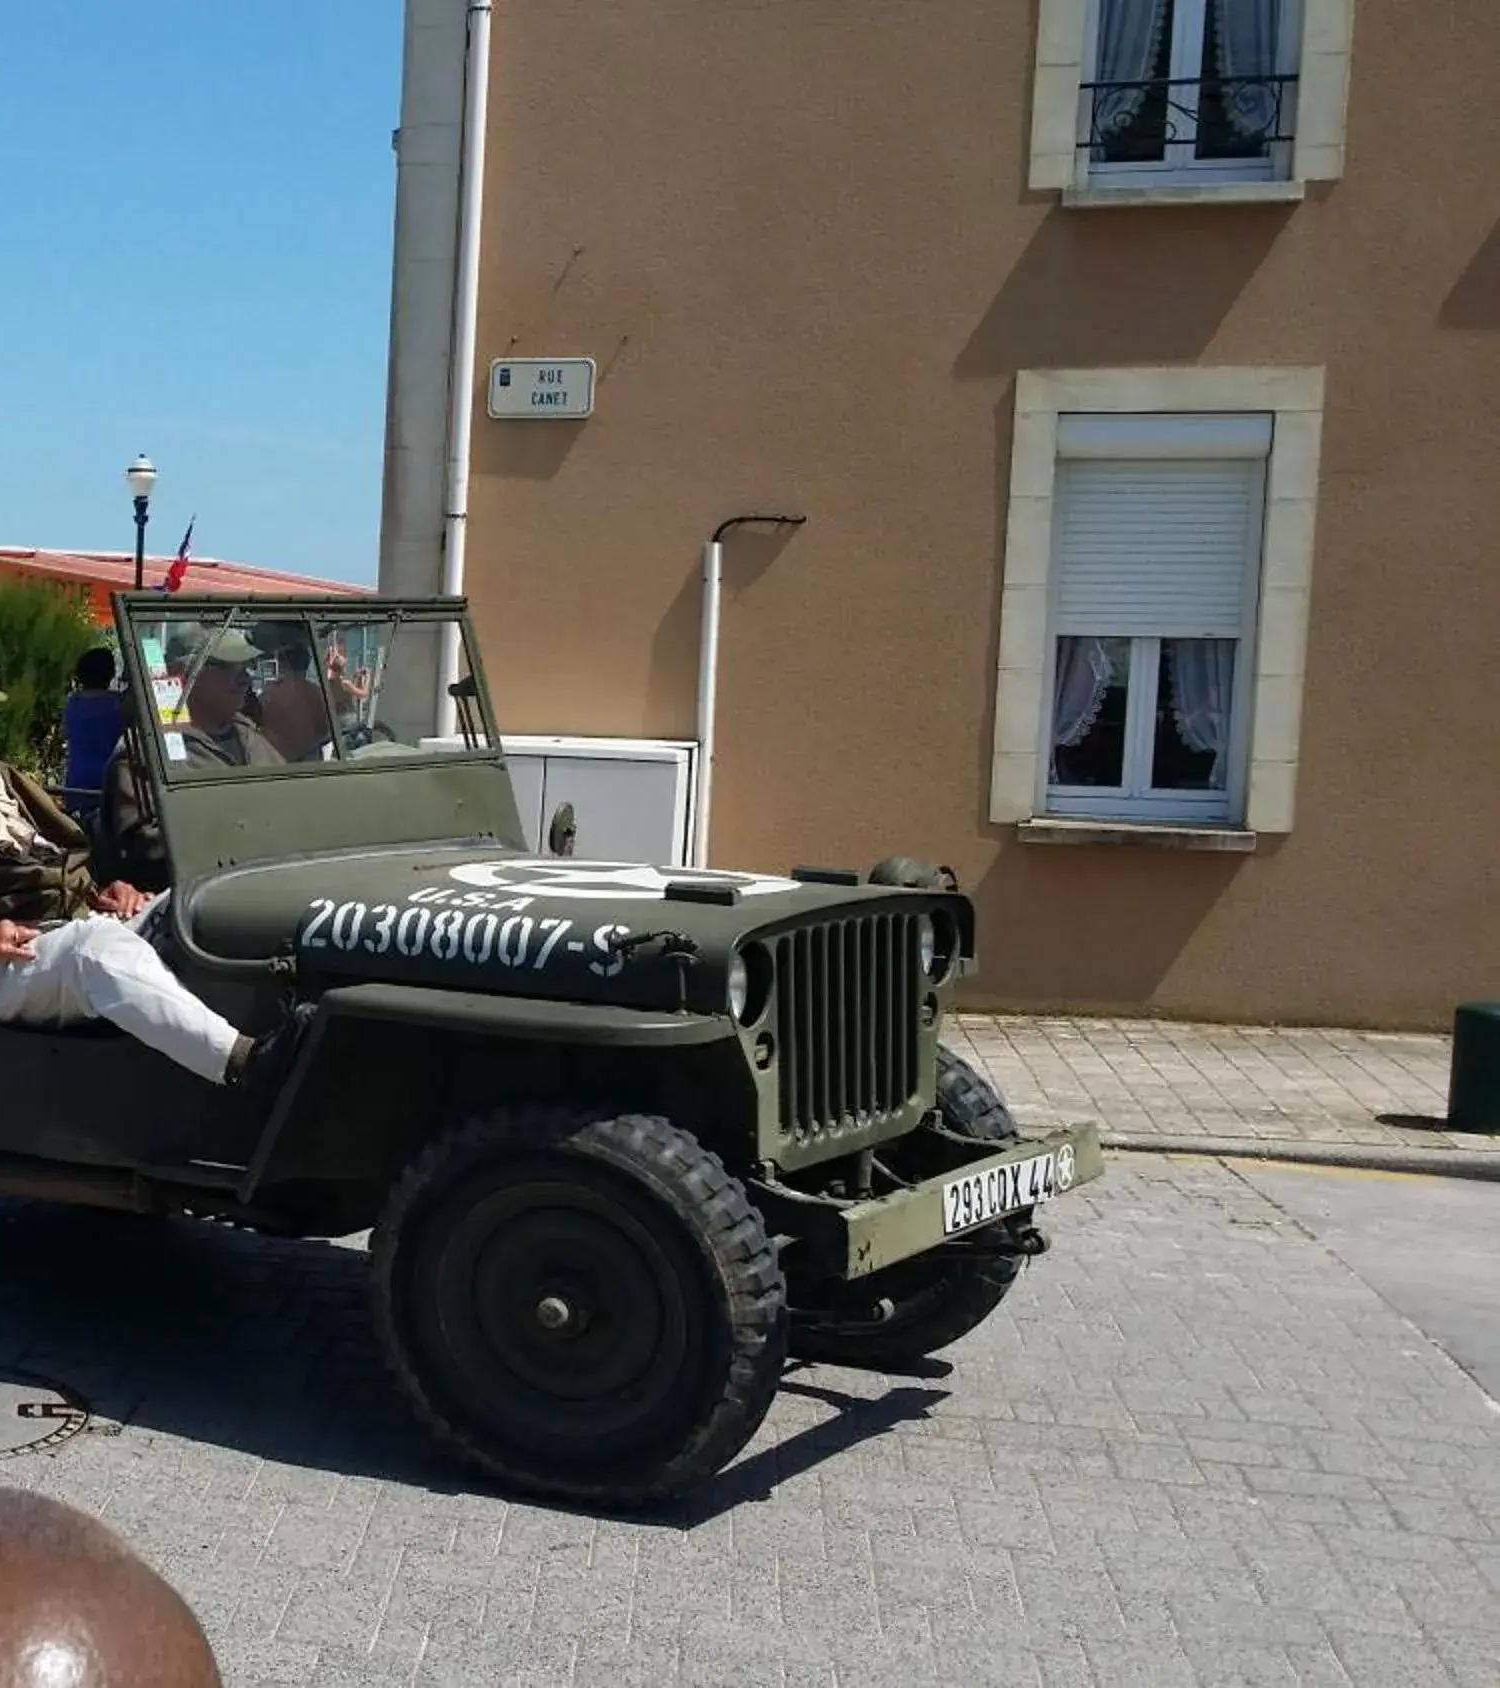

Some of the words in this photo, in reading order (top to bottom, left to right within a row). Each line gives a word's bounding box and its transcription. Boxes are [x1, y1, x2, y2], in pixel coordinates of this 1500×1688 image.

[531, 391, 569, 406] CANET
[538, 369, 564, 385] RUE
[300, 897, 631, 978] 20308007-S
[950, 1177, 984, 1229] 293
[1029, 1156, 1054, 1198] 44
